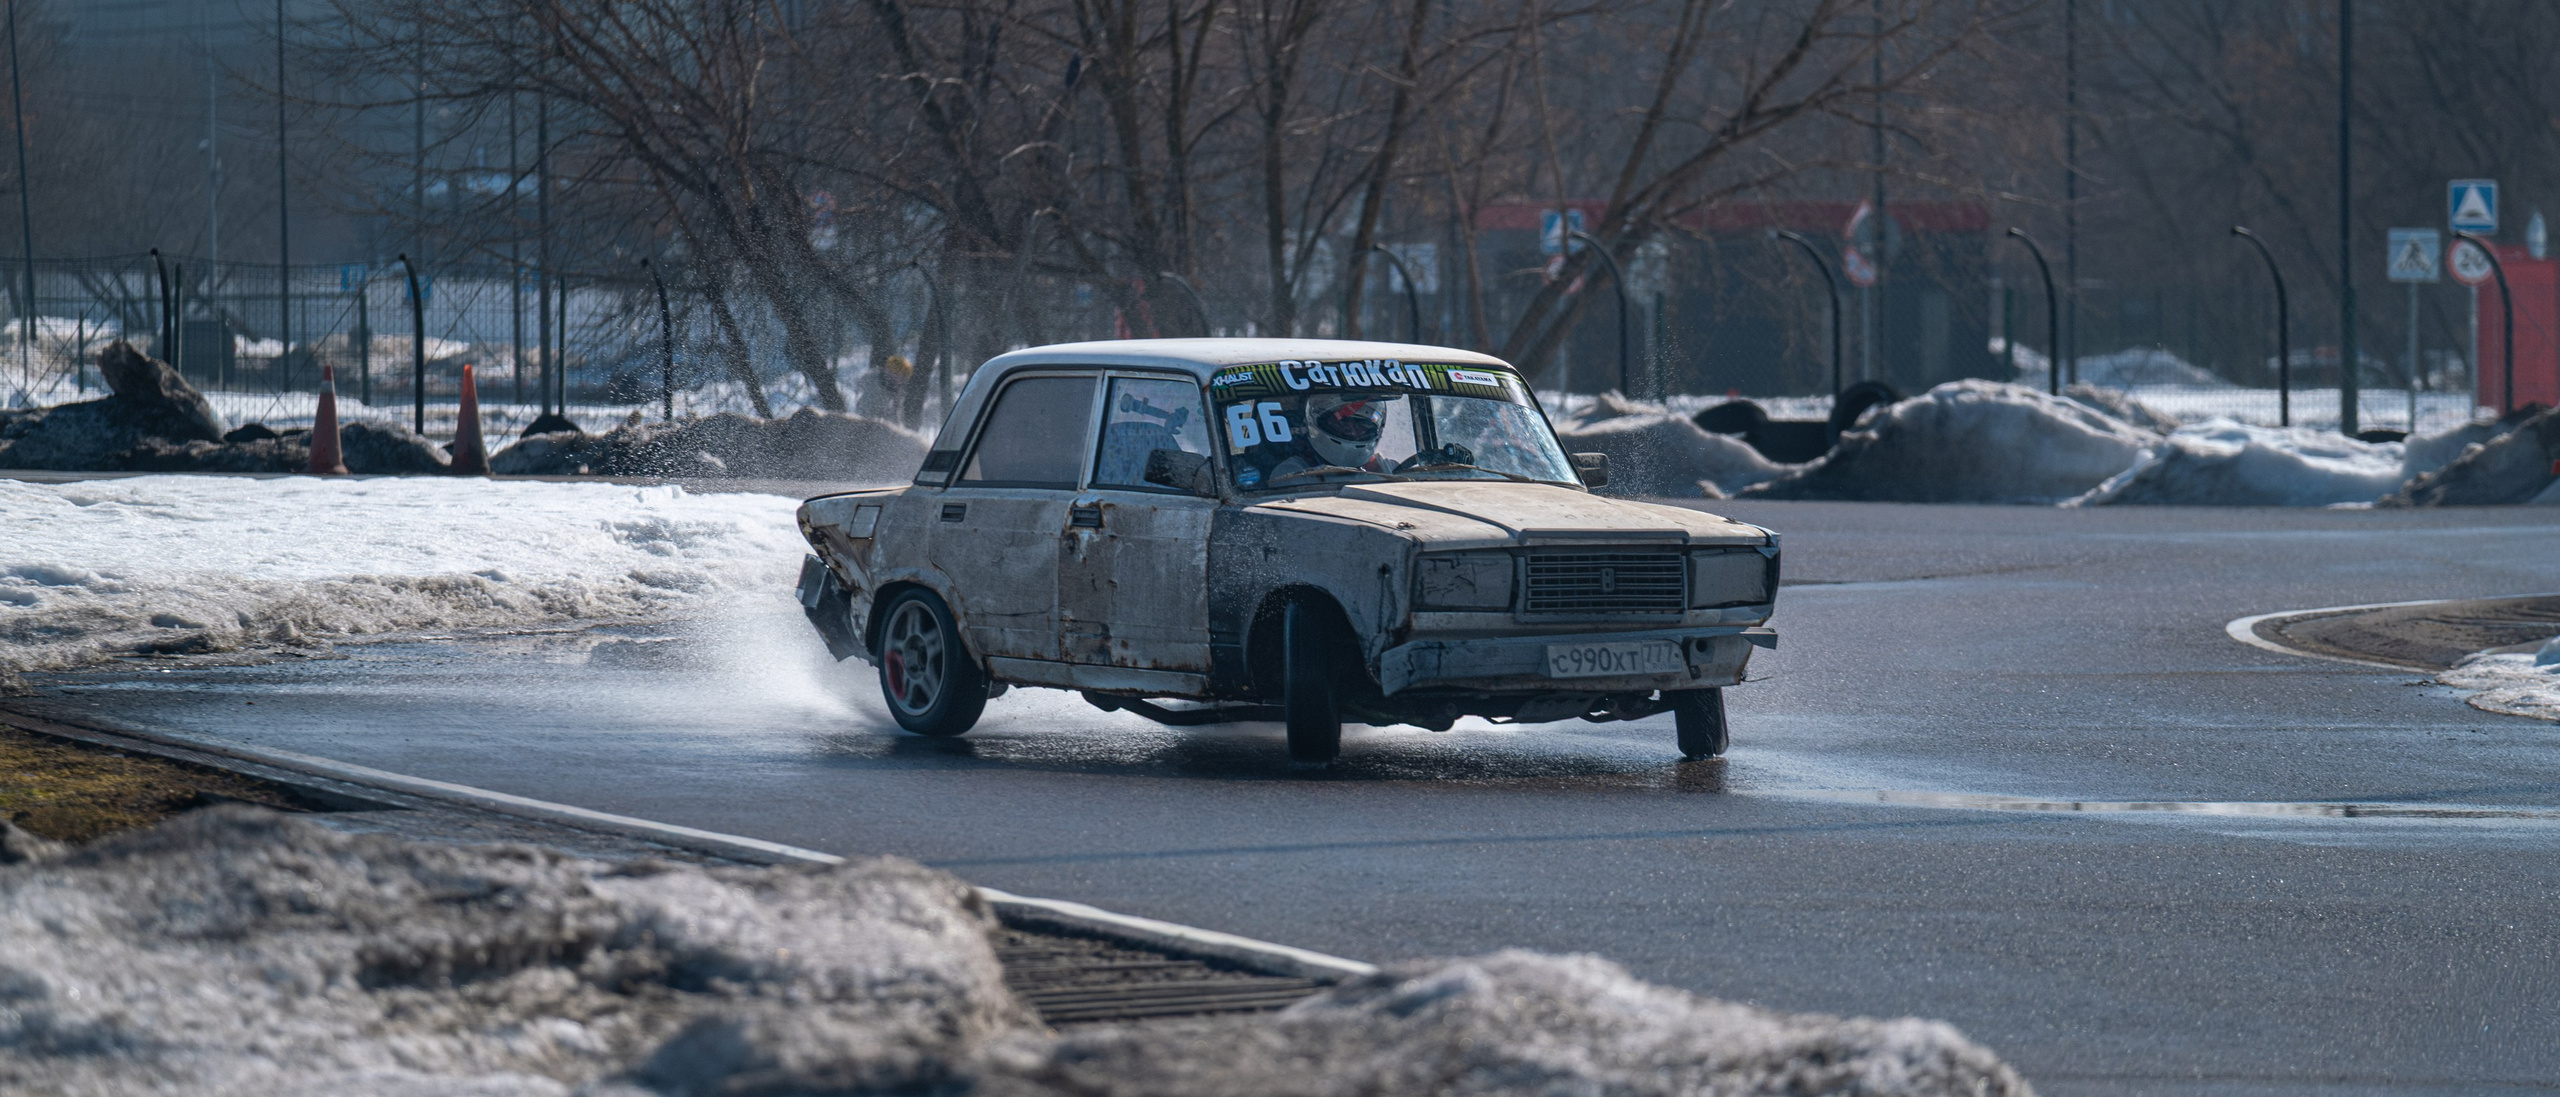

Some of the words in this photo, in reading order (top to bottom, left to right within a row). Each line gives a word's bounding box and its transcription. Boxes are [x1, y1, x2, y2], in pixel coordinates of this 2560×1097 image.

[1212, 371, 1254, 387] XHAUST
[1227, 401, 1293, 448] 66
[1642, 643, 1673, 663] 777
